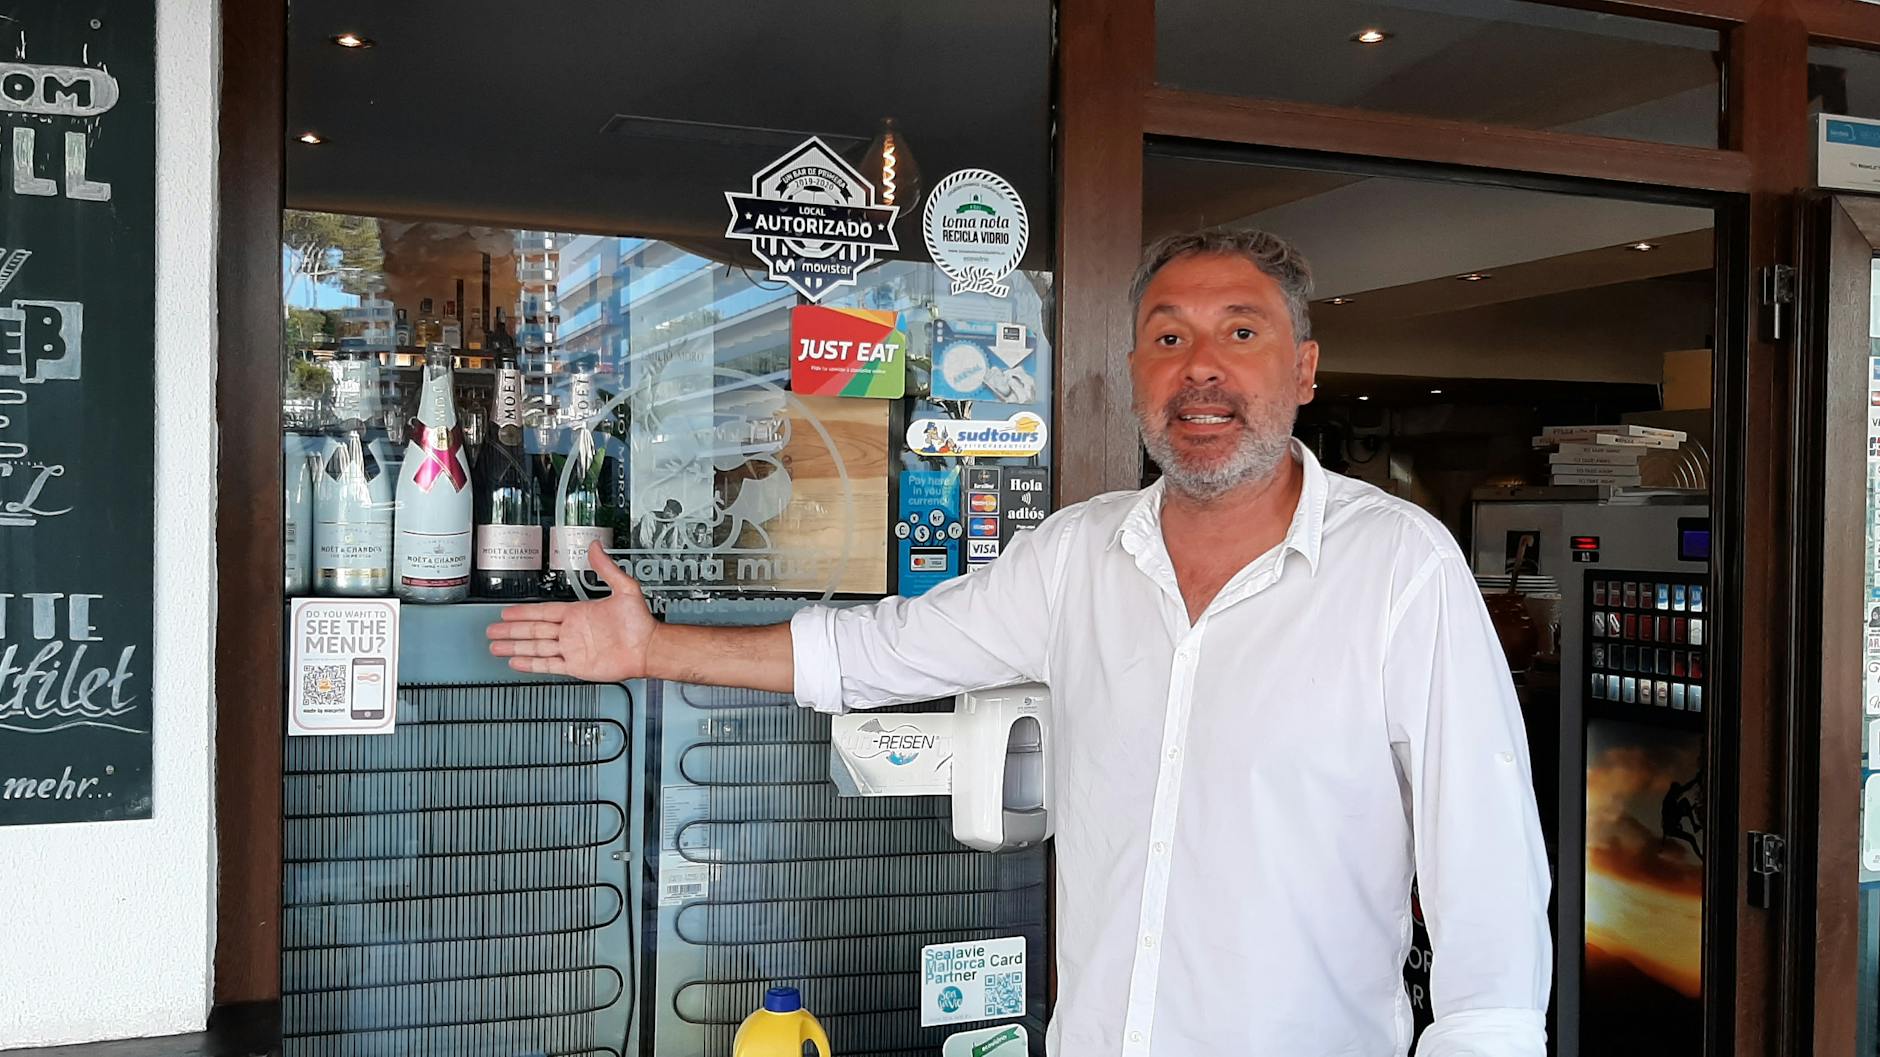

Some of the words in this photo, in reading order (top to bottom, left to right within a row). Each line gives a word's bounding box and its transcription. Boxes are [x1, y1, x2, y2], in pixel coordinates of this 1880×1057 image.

[799, 206, 826, 217] LOCAL
[755, 213, 873, 238] AUTORIZADO
[943, 230, 979, 243] RECICLA
[980, 232, 1009, 245] VIDRIO
[801, 262, 852, 275] movistar
[797, 338, 853, 362] JUST
[857, 342, 900, 363] EAT
[957, 427, 1039, 443] sudtours
[1010, 478, 1043, 491] Hola
[1007, 507, 1045, 520] adiós
[973, 544, 997, 554] VISA
[306, 610, 320, 619] DO
[322, 610, 343, 619] YOU
[344, 610, 372, 619] WANT
[374, 610, 387, 619] TO
[306, 620, 341, 635] SEE
[347, 620, 386, 635] THE
[305, 636, 386, 654] MENU?
[925, 944, 985, 961] Sealavie
[925, 957, 986, 972] Mallorca
[990, 951, 1023, 967] Card
[925, 970, 977, 985] Partner
